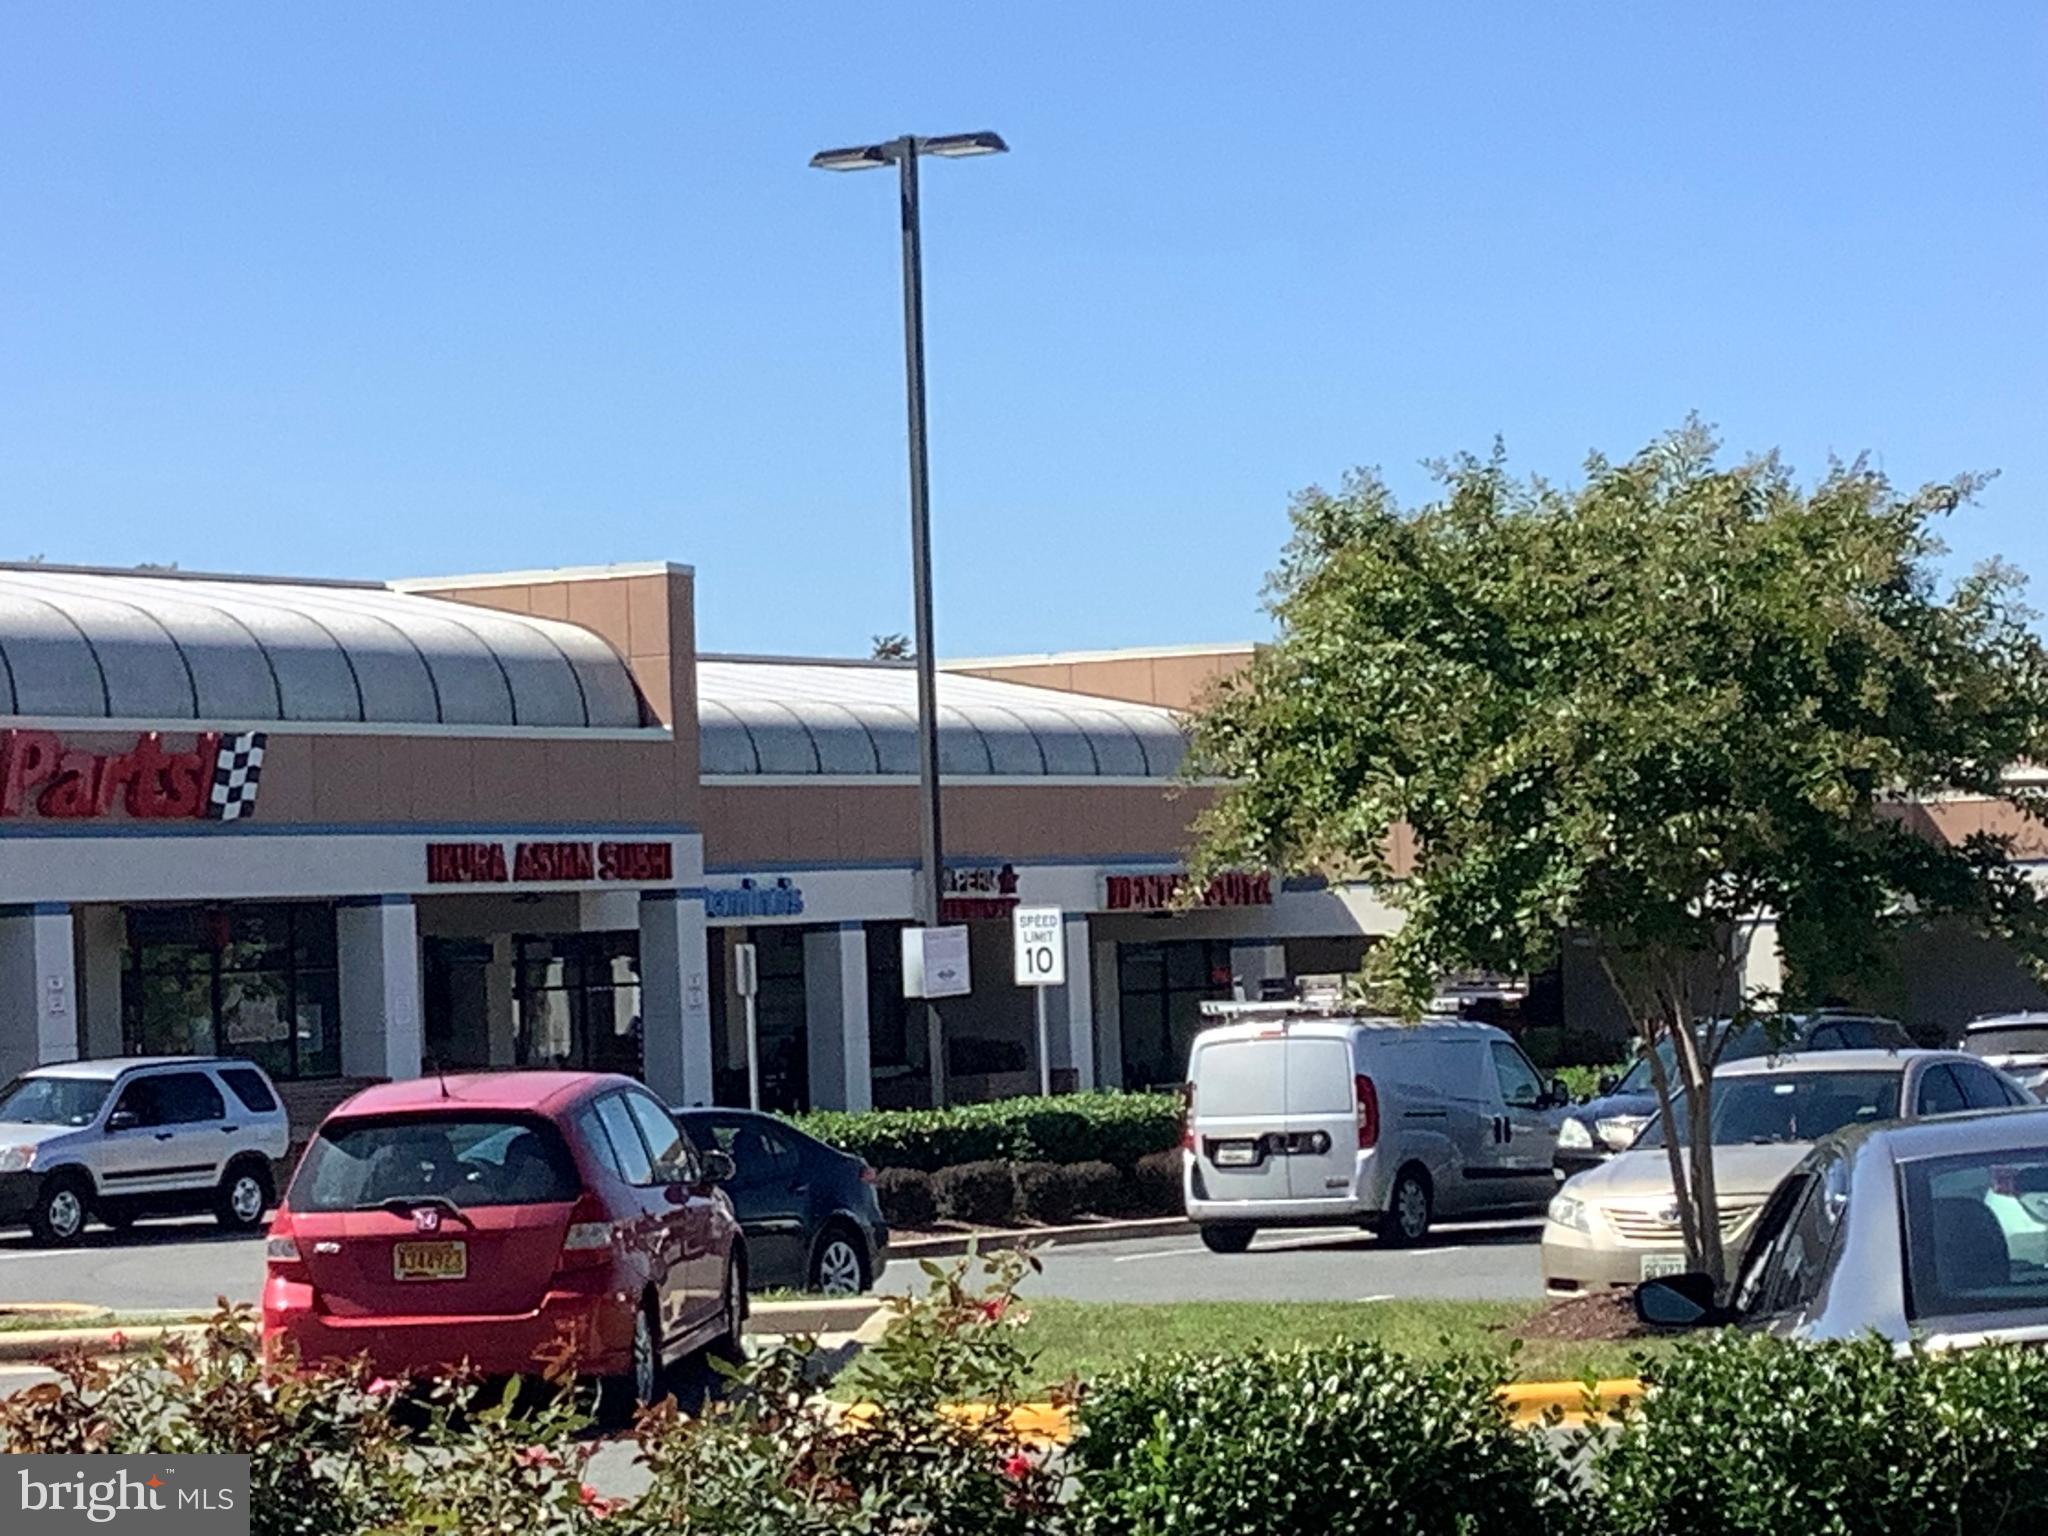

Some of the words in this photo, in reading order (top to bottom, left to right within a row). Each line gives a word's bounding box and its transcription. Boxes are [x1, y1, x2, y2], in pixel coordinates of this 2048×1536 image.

[514, 842, 594, 881] ASIAN
[598, 842, 673, 880] SUSHI
[1019, 914, 1058, 928] SPEED
[1023, 931, 1054, 943] LIMIT
[1025, 946, 1054, 974] 10
